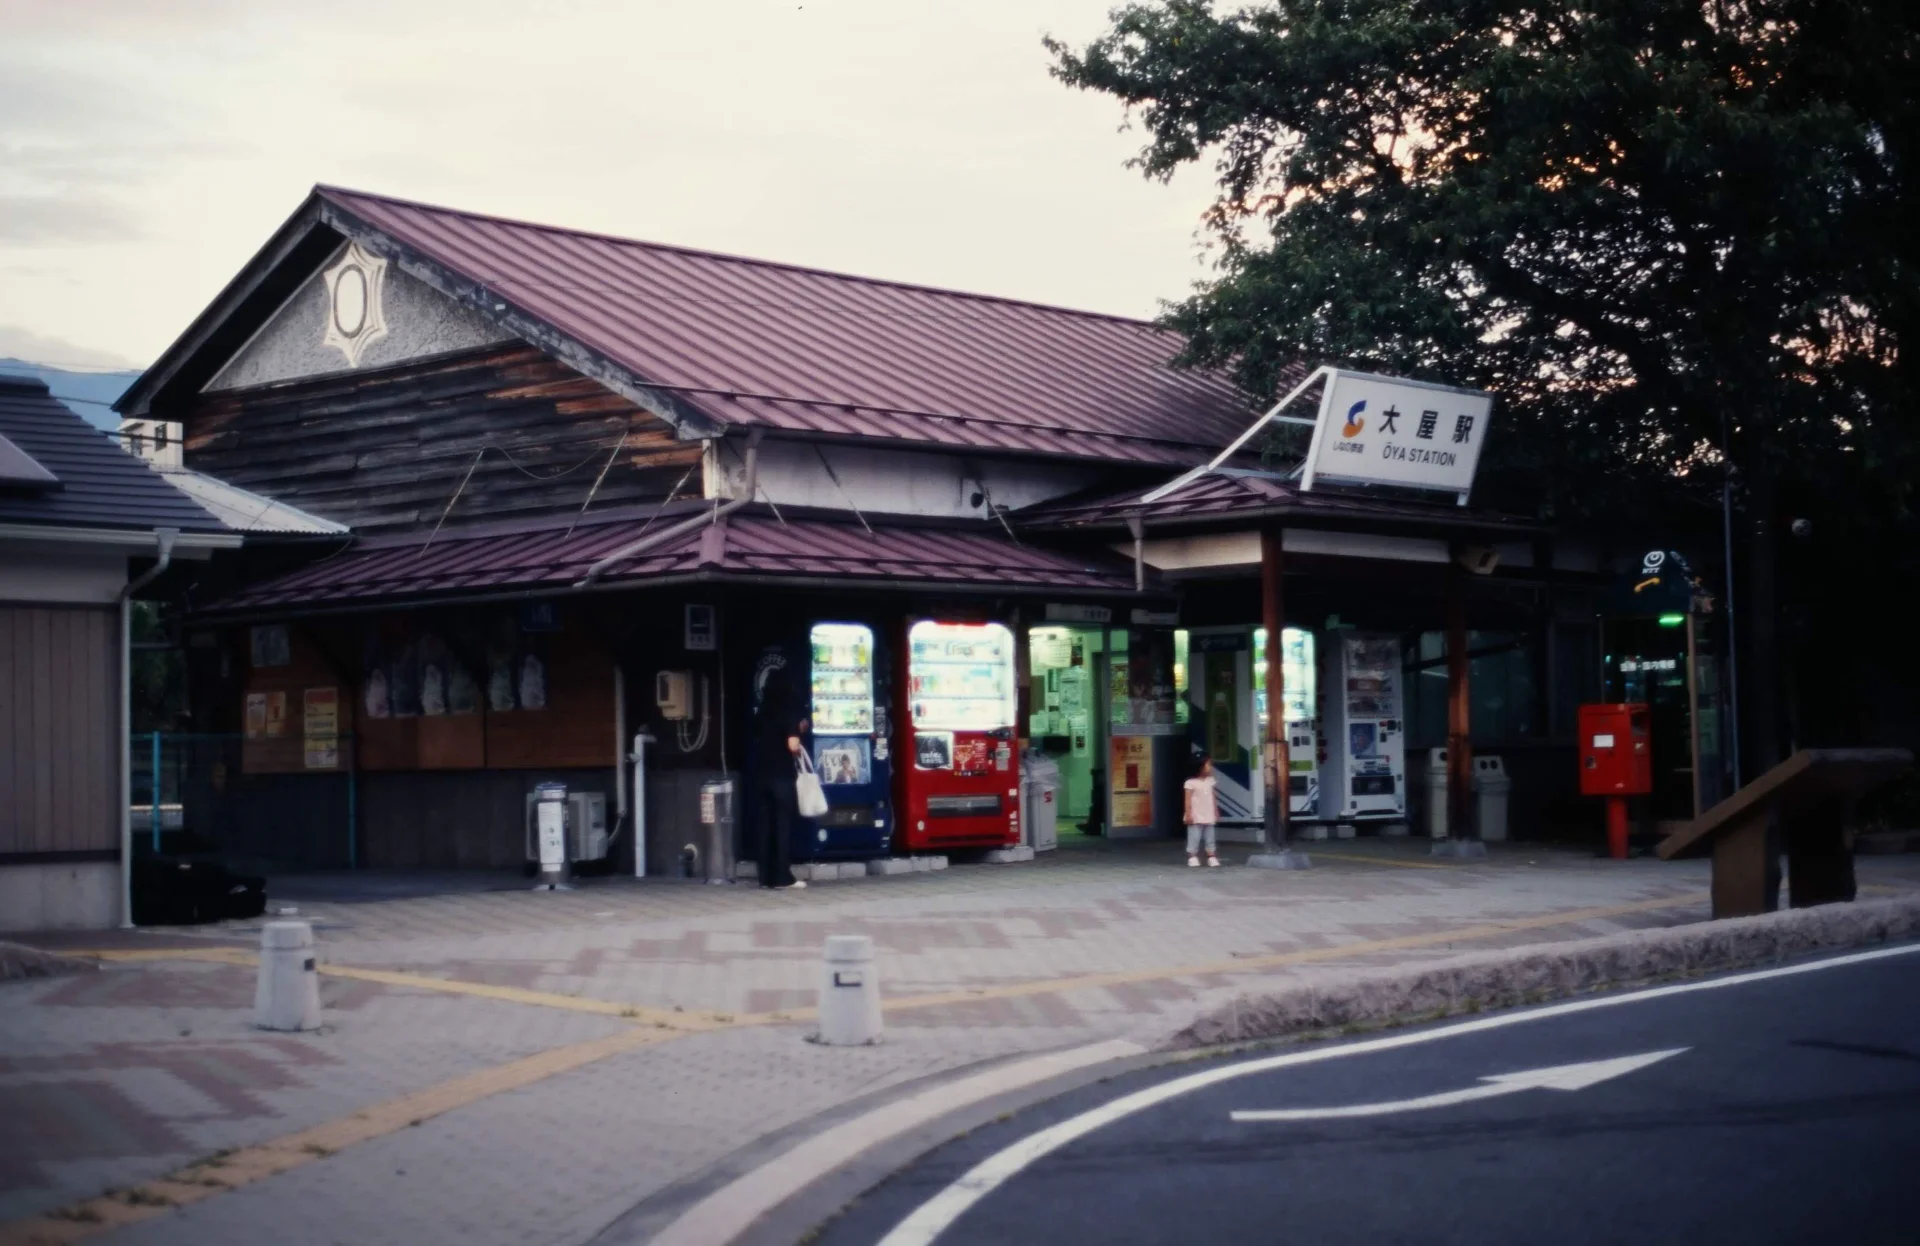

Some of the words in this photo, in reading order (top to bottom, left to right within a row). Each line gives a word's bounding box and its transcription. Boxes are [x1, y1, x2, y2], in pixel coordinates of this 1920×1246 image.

[1379, 404, 1475, 444] 大屋駅
[1409, 448, 1457, 467] STATION
